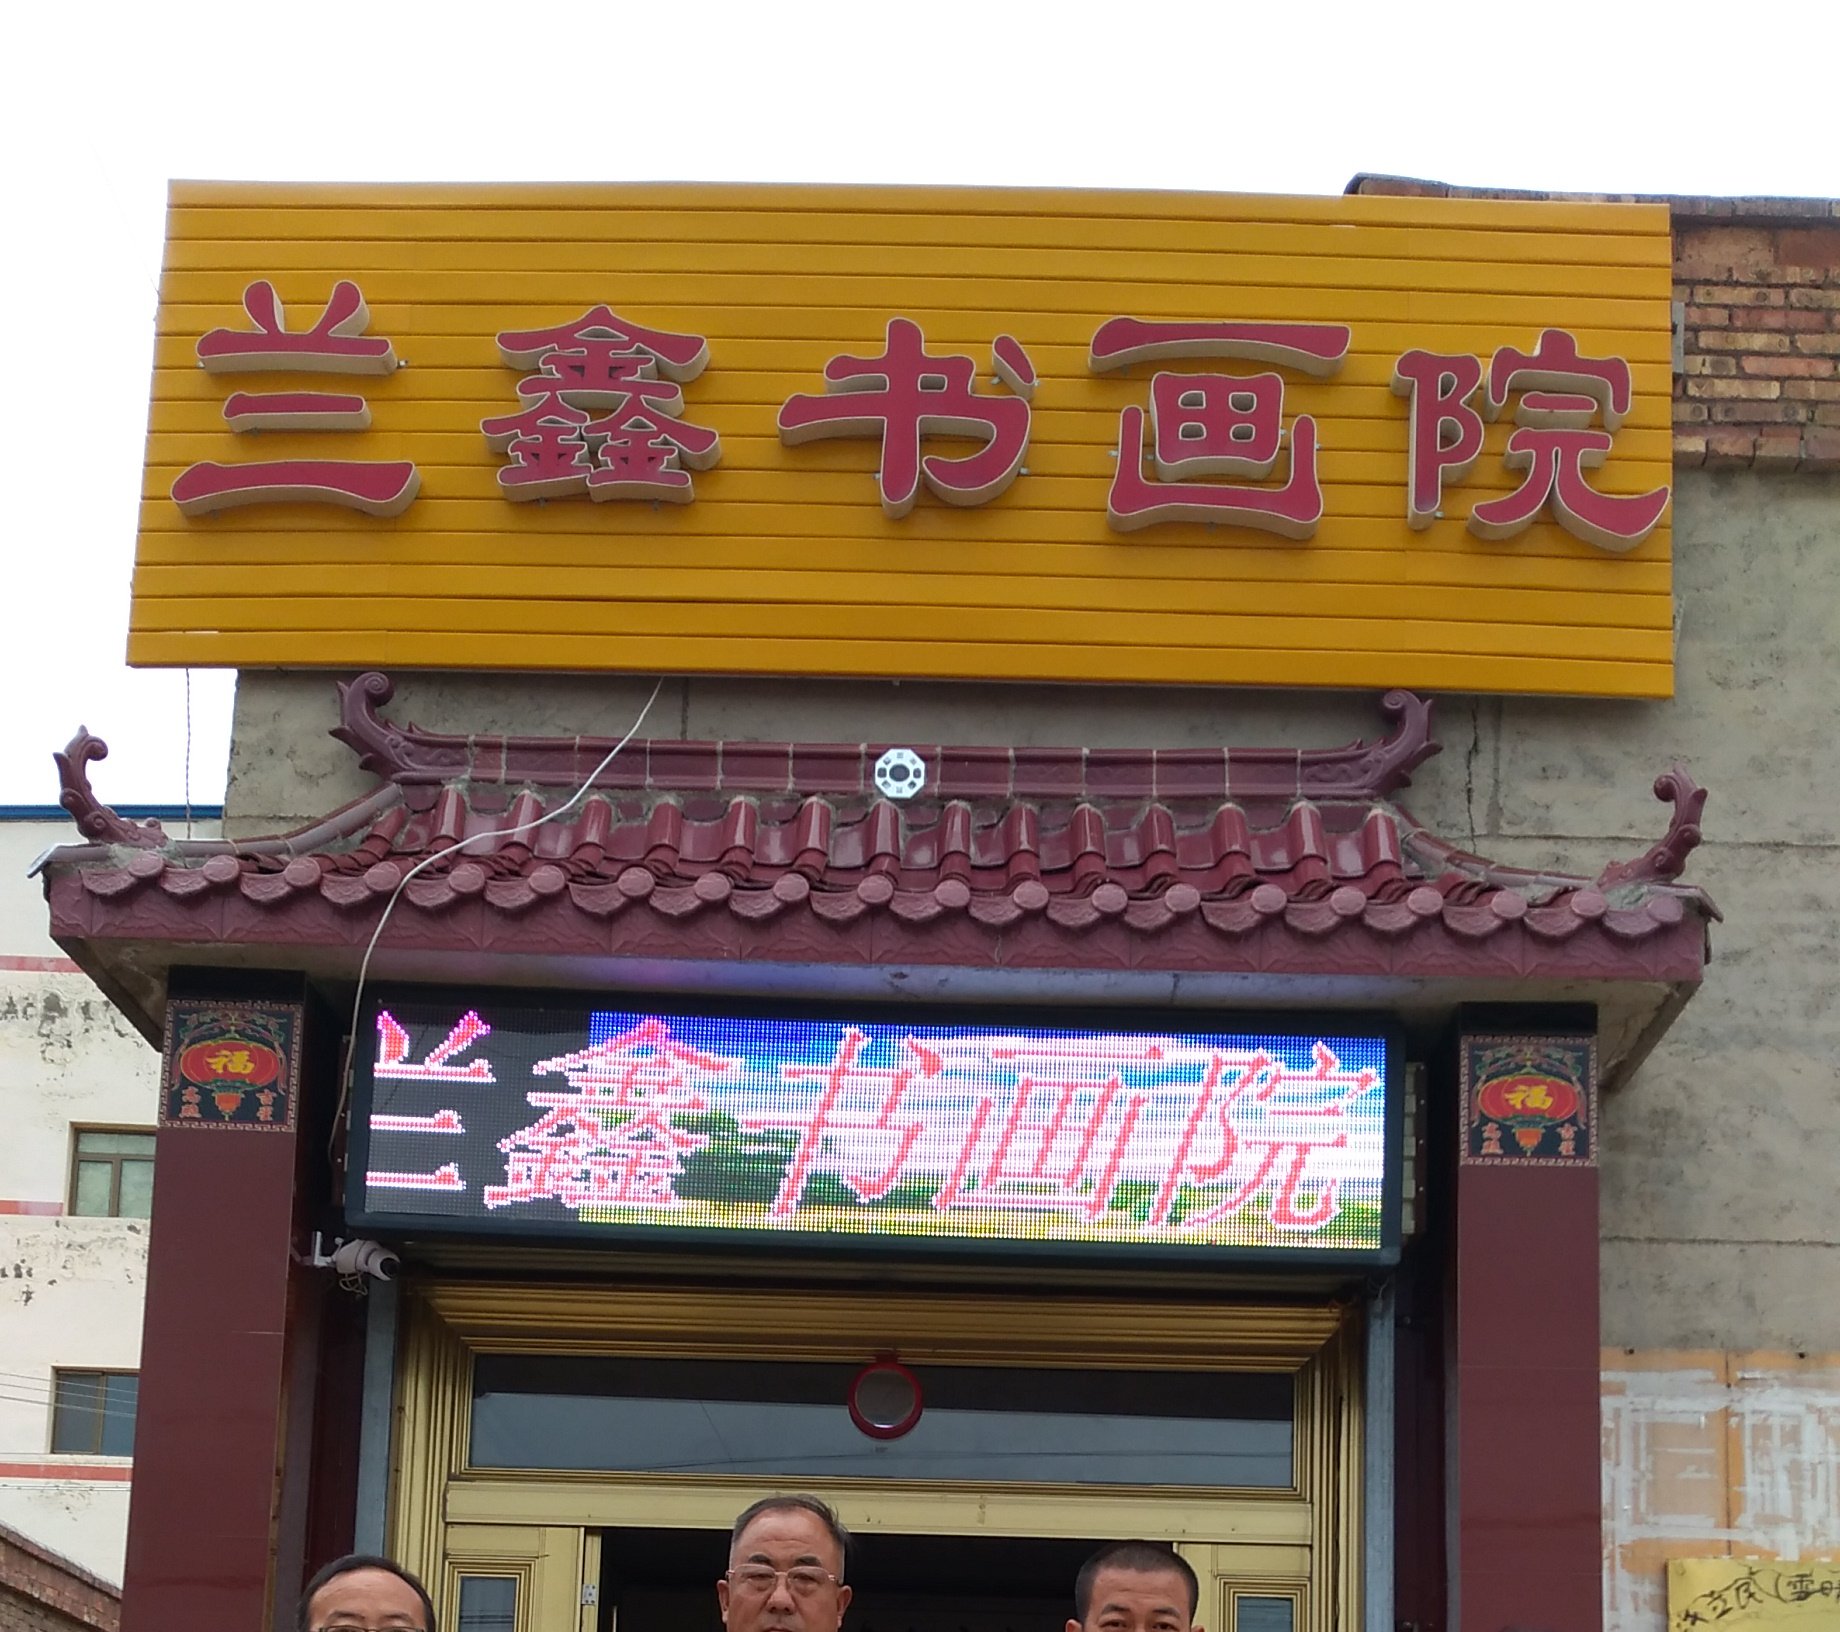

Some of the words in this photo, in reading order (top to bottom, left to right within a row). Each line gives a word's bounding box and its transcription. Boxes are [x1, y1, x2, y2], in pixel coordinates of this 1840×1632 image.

[170, 279, 1671, 552] 兰鑫书画院
[205, 1049, 255, 1075] 福
[365, 1009, 1380, 1230] 兰鑫书画院
[1504, 1084, 1554, 1111] 福
